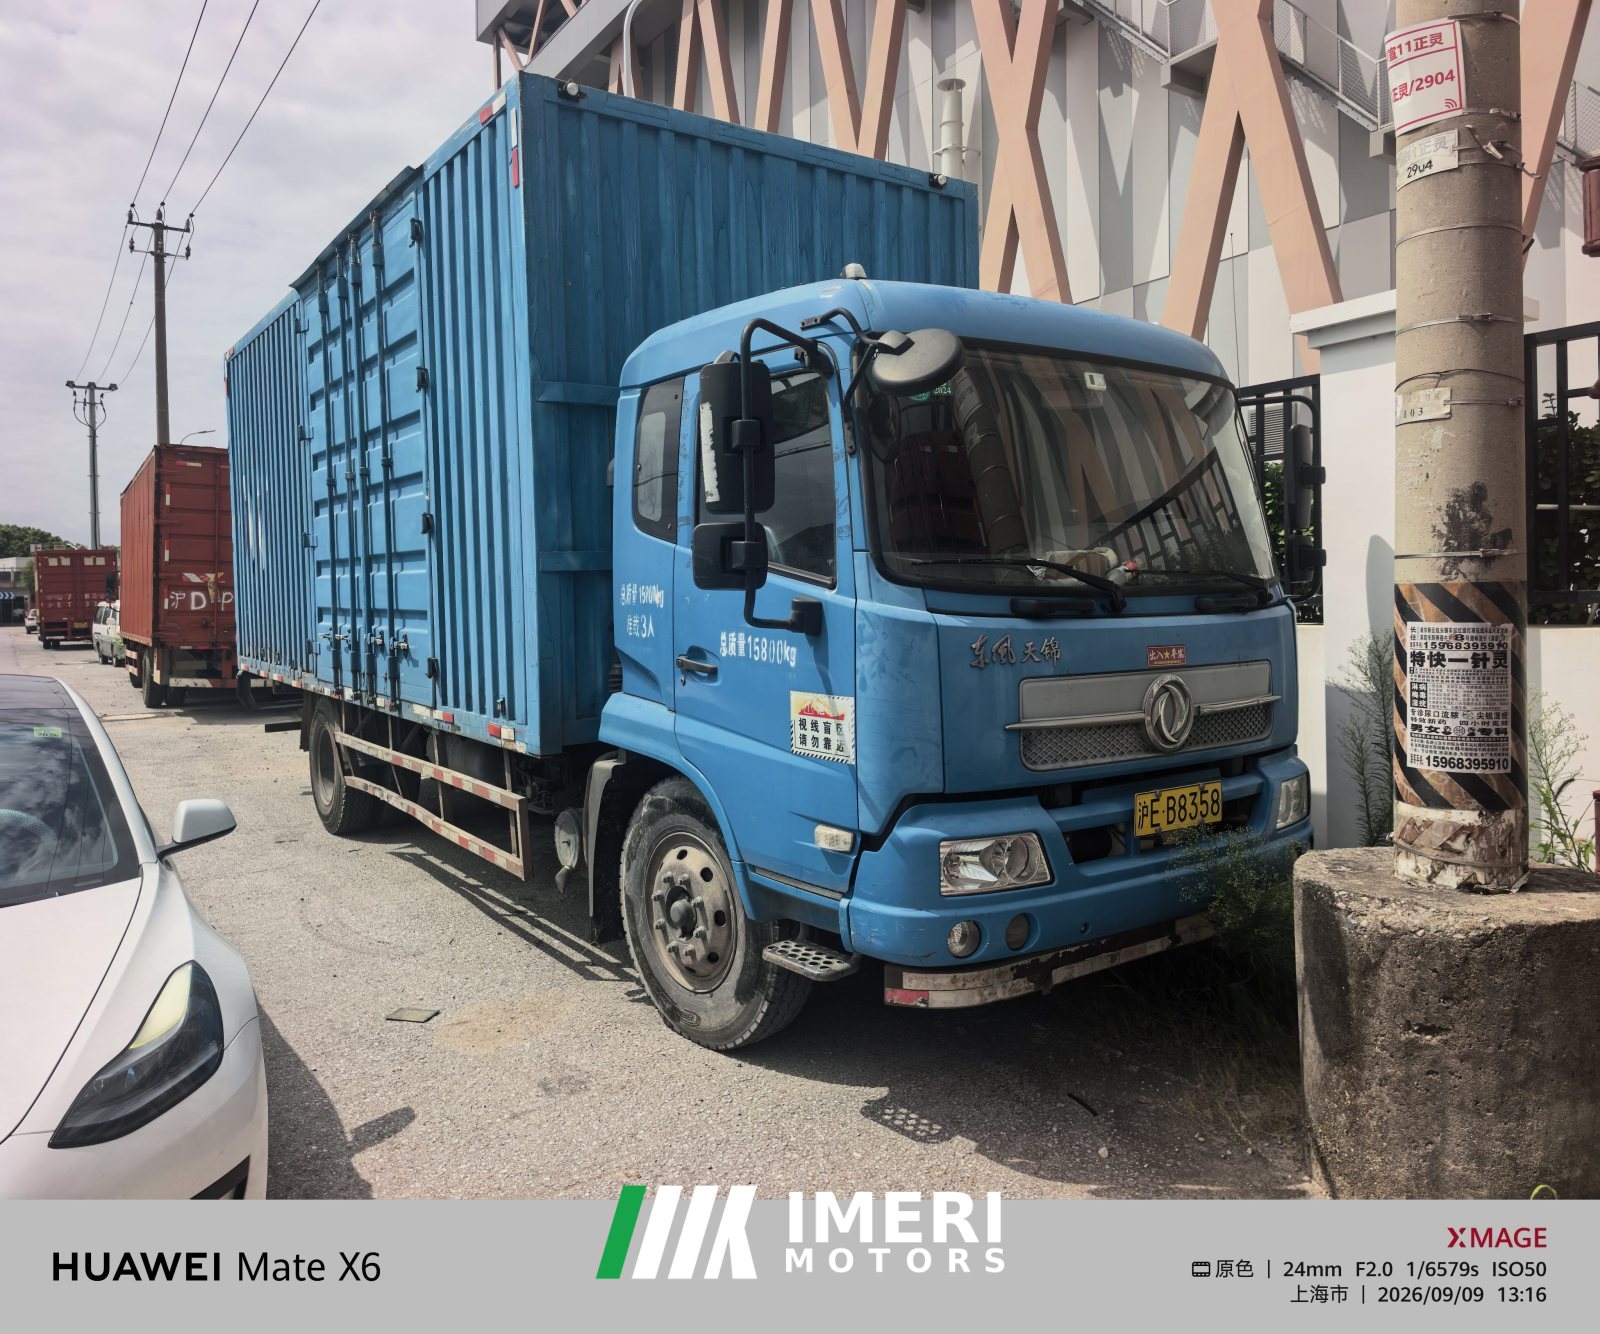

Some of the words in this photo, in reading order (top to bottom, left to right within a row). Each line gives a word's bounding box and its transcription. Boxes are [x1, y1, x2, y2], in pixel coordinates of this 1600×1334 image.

[1424, 642, 1508, 650] 15968395910
[1410, 651, 1508, 669] 特快一针灵
[798, 717, 844, 736] 视线盲区
[1425, 755, 1509, 770] 15968395910
